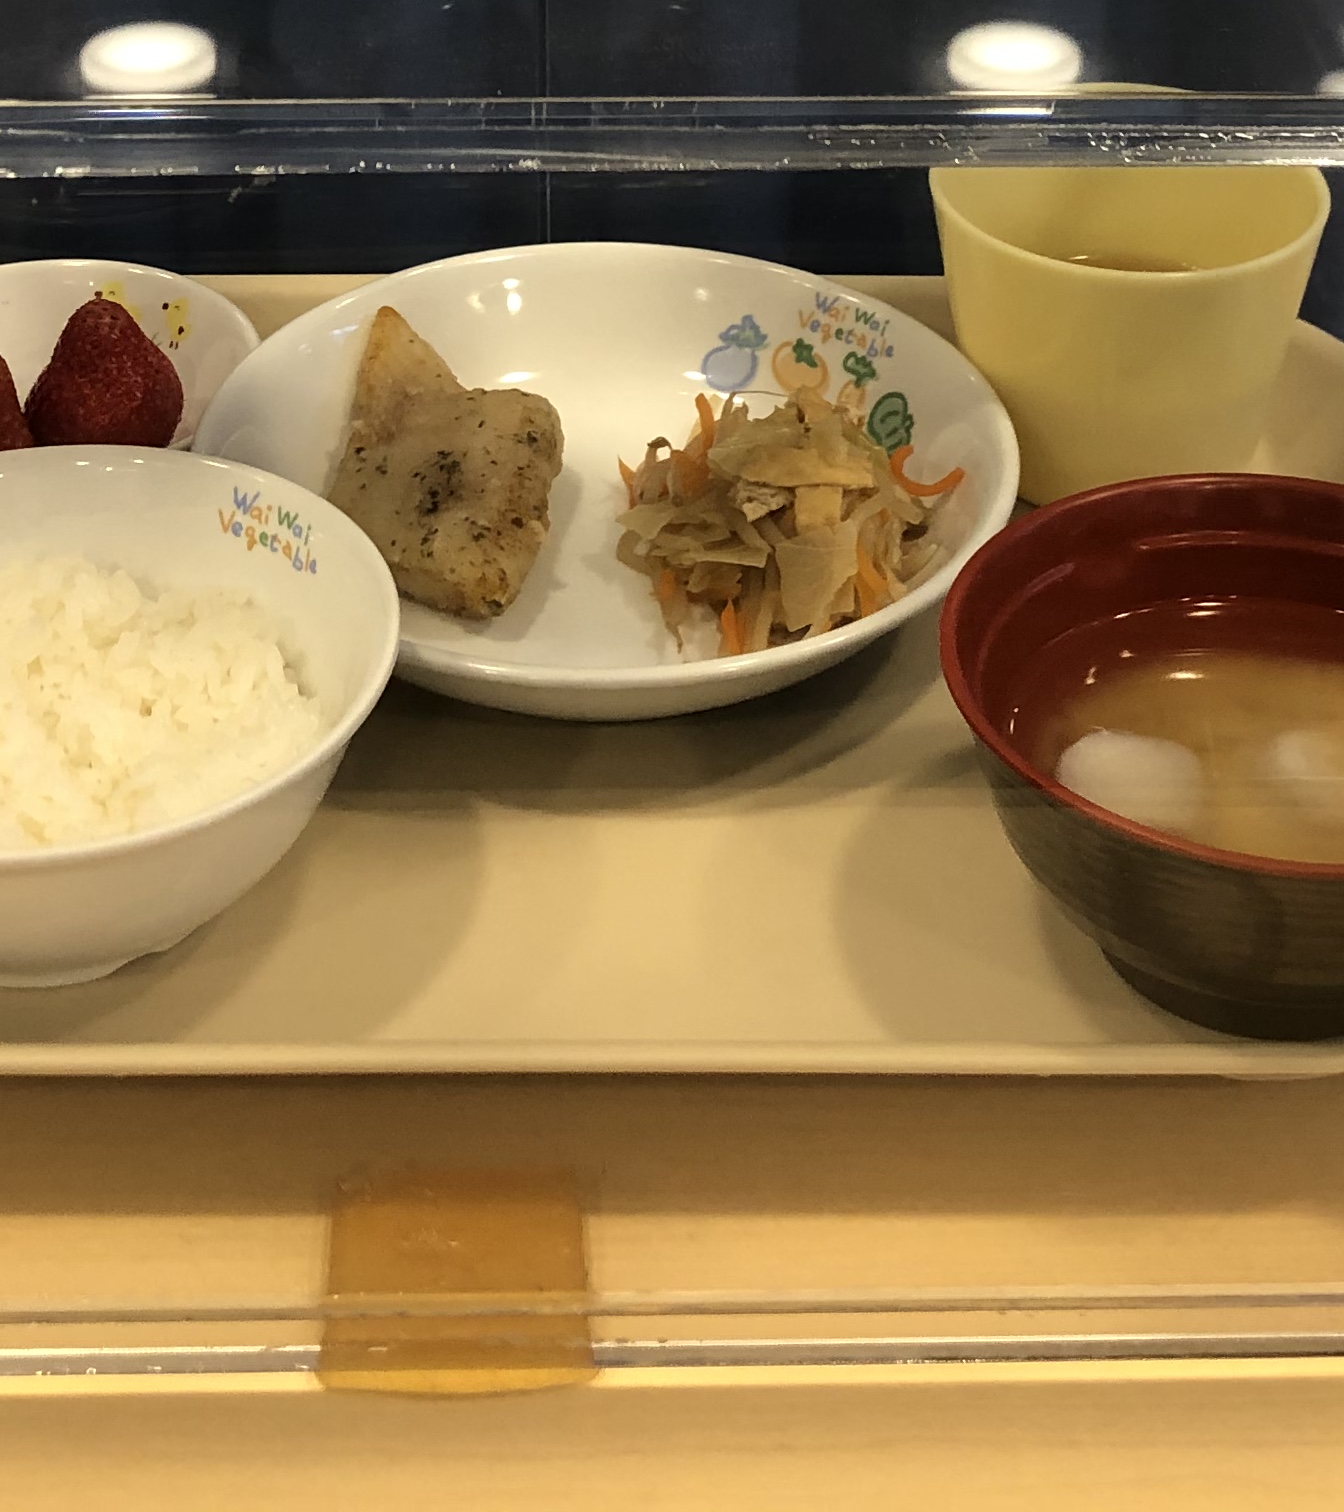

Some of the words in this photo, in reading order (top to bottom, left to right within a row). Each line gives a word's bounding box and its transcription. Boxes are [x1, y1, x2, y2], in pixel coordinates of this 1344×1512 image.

[798, 308, 896, 359] Vegetable
[815, 290, 850, 324] Wai
[854, 306, 891, 338] Wai
[218, 507, 317, 575] Vegetable
[233, 485, 273, 526] Wai
[277, 504, 312, 547] Wai
